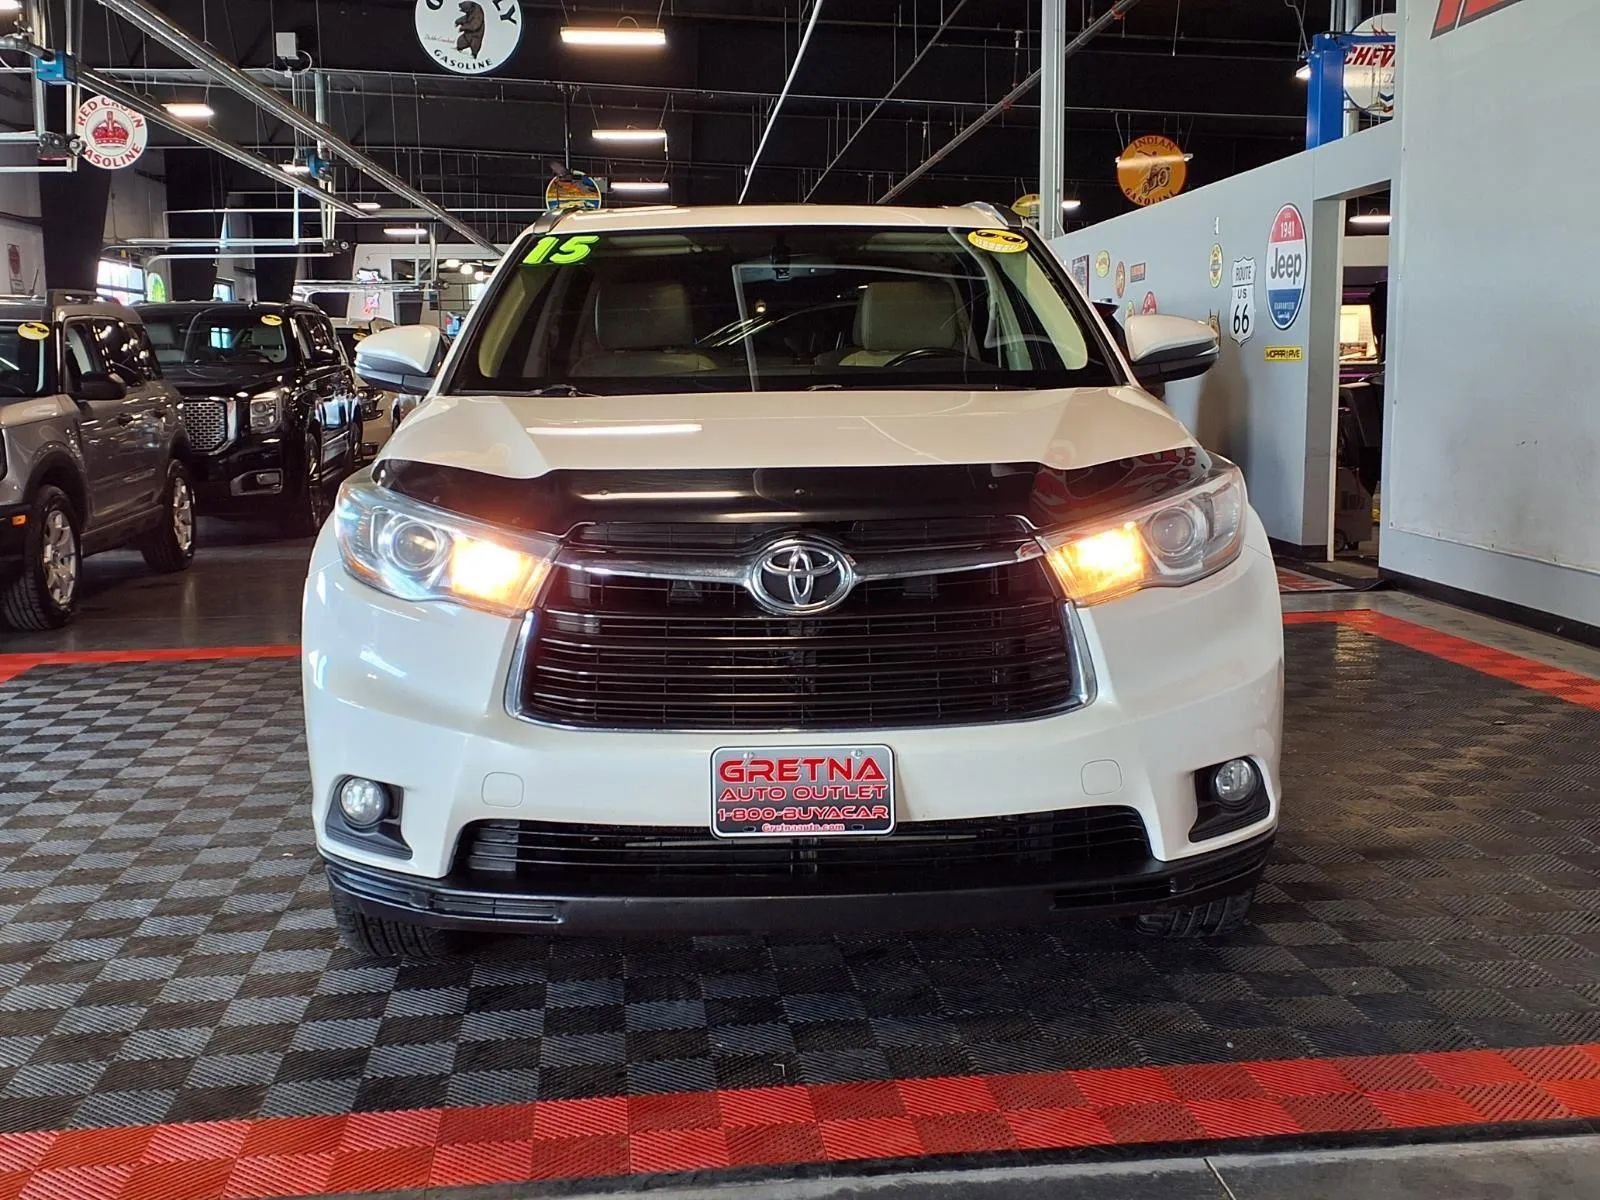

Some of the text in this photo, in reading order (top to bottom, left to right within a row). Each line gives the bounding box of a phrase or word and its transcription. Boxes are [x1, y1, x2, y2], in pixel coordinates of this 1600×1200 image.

[434, 49, 493, 70] GASOLINE
[1343, 43, 1395, 68] CHEV
[77, 101, 98, 126] RED
[1133, 136, 1176, 152] INDIAN
[84, 142, 142, 168] ASOLINE
[1280, 221, 1296, 239] 1941
[522, 235, 600, 264] 15
[1235, 265, 1252, 282] ROUTE
[1271, 247, 1302, 285] Jeep
[1237, 288, 1248, 300] US
[1233, 303, 1250, 335] 66
[719, 756, 888, 783] GRETNA
[718, 784, 889, 802] AUTO OUTLET
[717, 805, 889, 822] 1-800-BUYACAR
[762, 823, 845, 832] Gretnaauto.com
